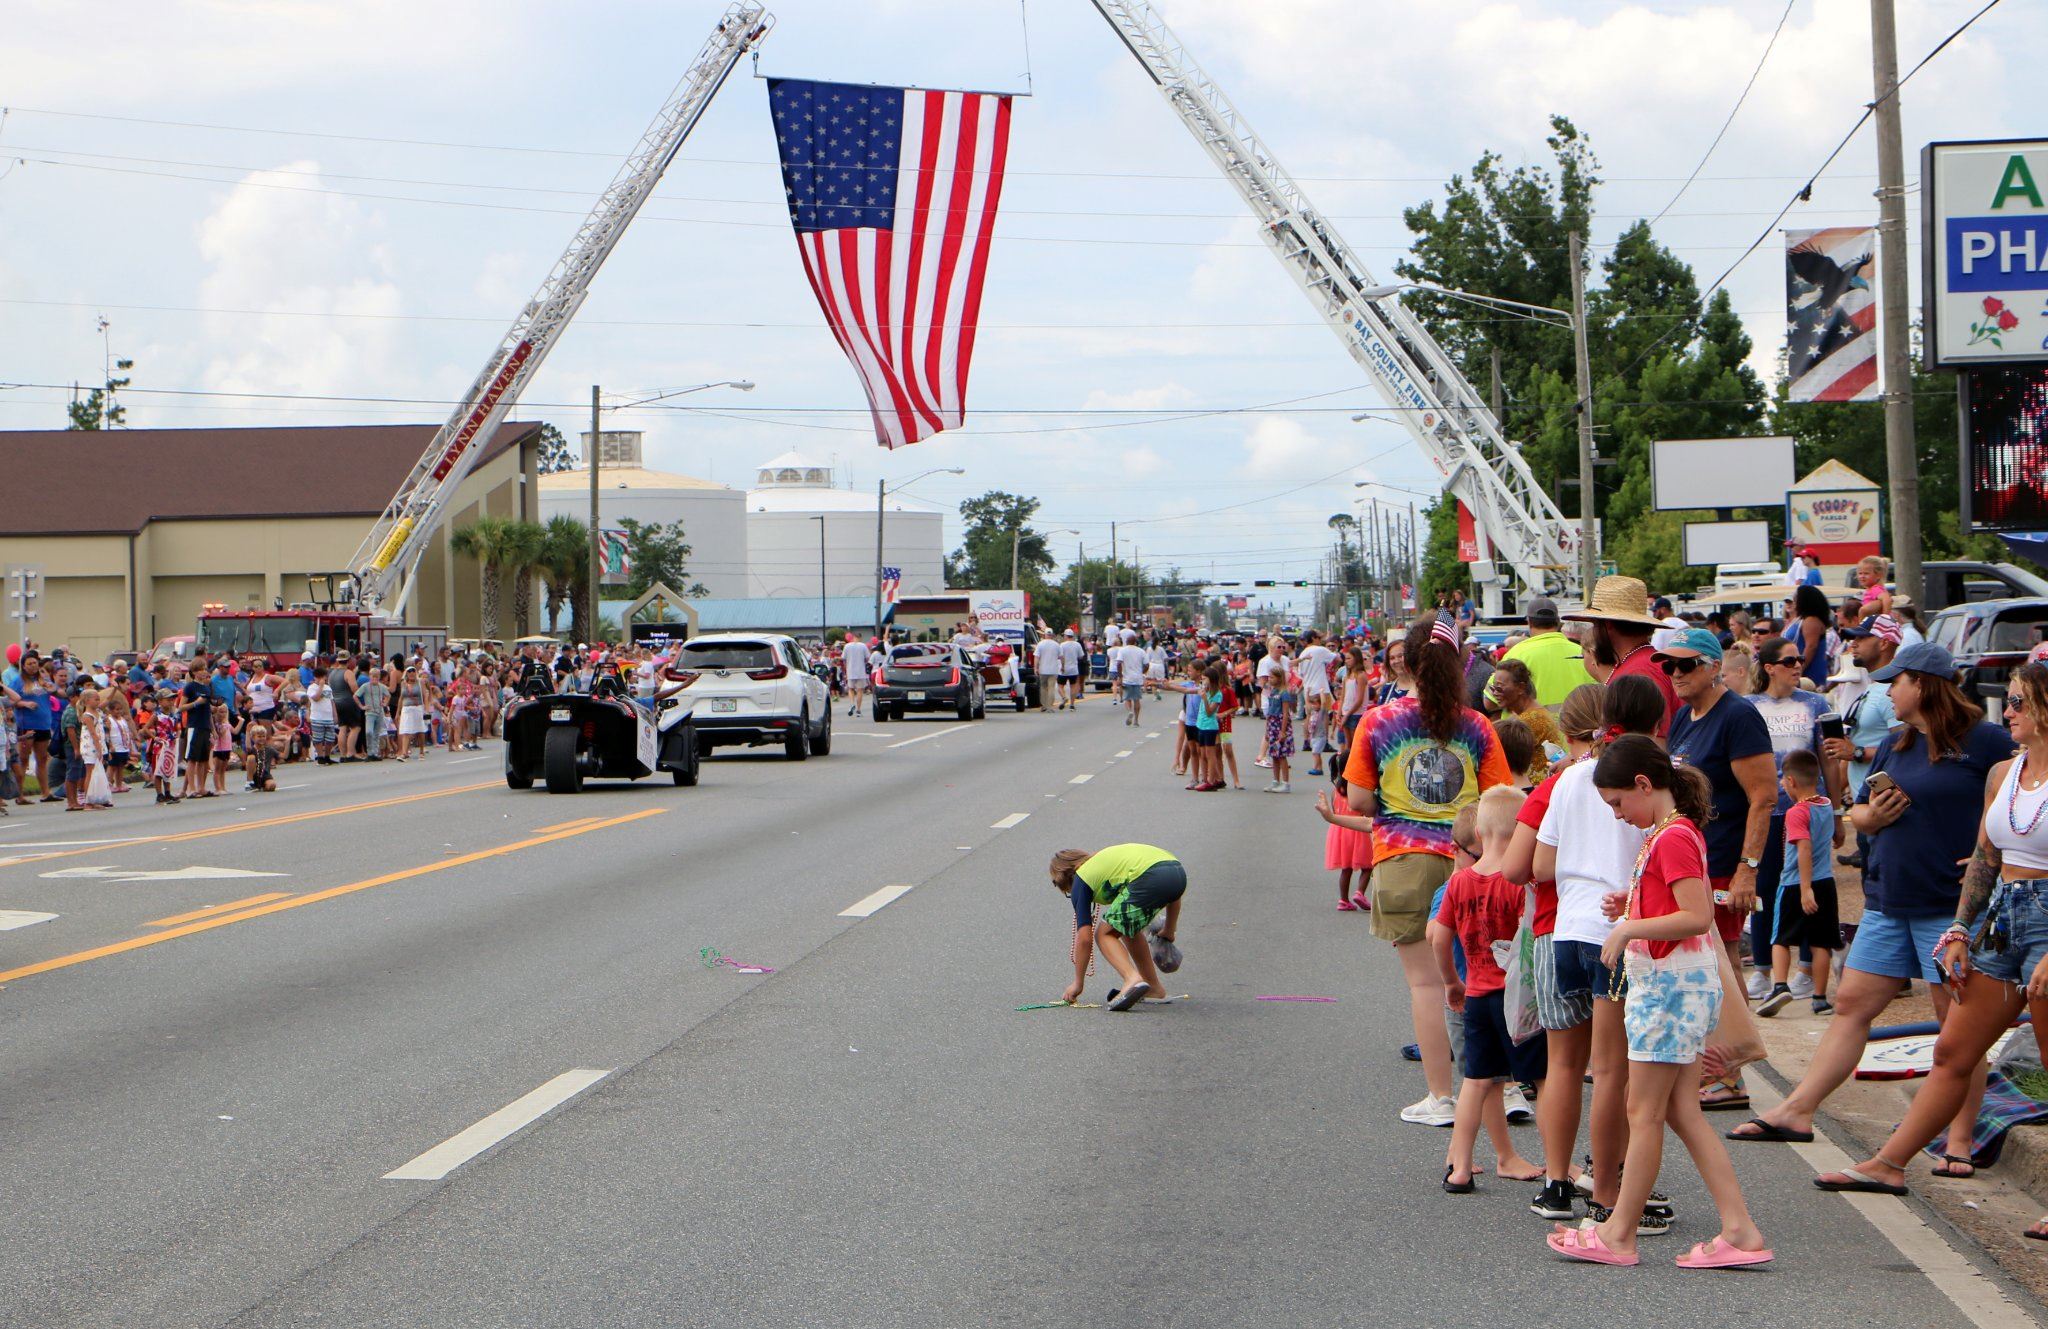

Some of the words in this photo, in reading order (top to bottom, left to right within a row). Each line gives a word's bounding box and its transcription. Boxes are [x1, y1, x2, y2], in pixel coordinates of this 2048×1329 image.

[1961, 230, 2048, 275] PH
[1354, 319, 1373, 341] BAY
[1372, 342, 1406, 383] COUNTY
[1404, 382, 1427, 411] FIRE
[1358, 338, 1377, 361] THOMAS
[1375, 360, 1390, 380] DRIVE
[1388, 378, 1410, 404] DISTRICT
[445, 419, 479, 466] LYNN
[478, 358, 521, 418] HAVEN
[1812, 499, 1860, 516] SCOOP'S
[974, 609, 1022, 621] eonard
[1766, 715, 1791, 725] UMP
[1768, 725, 1807, 733] SANTIS
